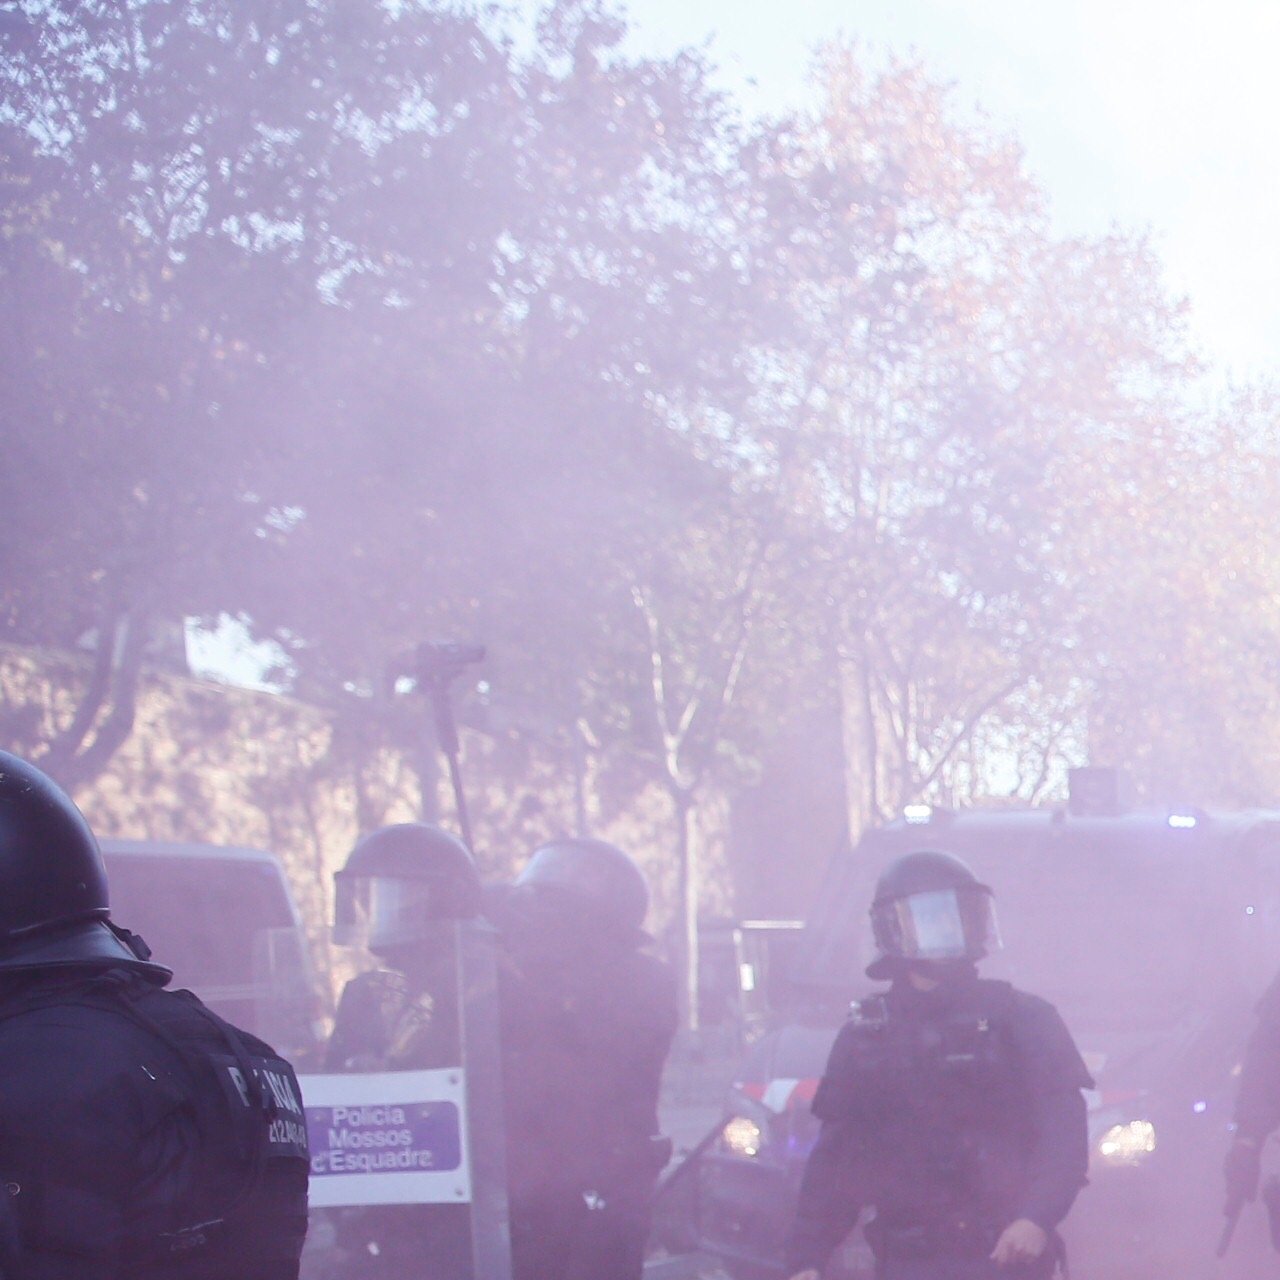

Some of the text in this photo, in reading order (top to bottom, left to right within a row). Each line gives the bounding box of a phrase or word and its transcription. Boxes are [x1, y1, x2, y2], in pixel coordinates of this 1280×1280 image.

[227, 1066, 302, 1115] PICIA
[332, 1104, 406, 1127] Policia
[328, 1128, 413, 1149] Mossos
